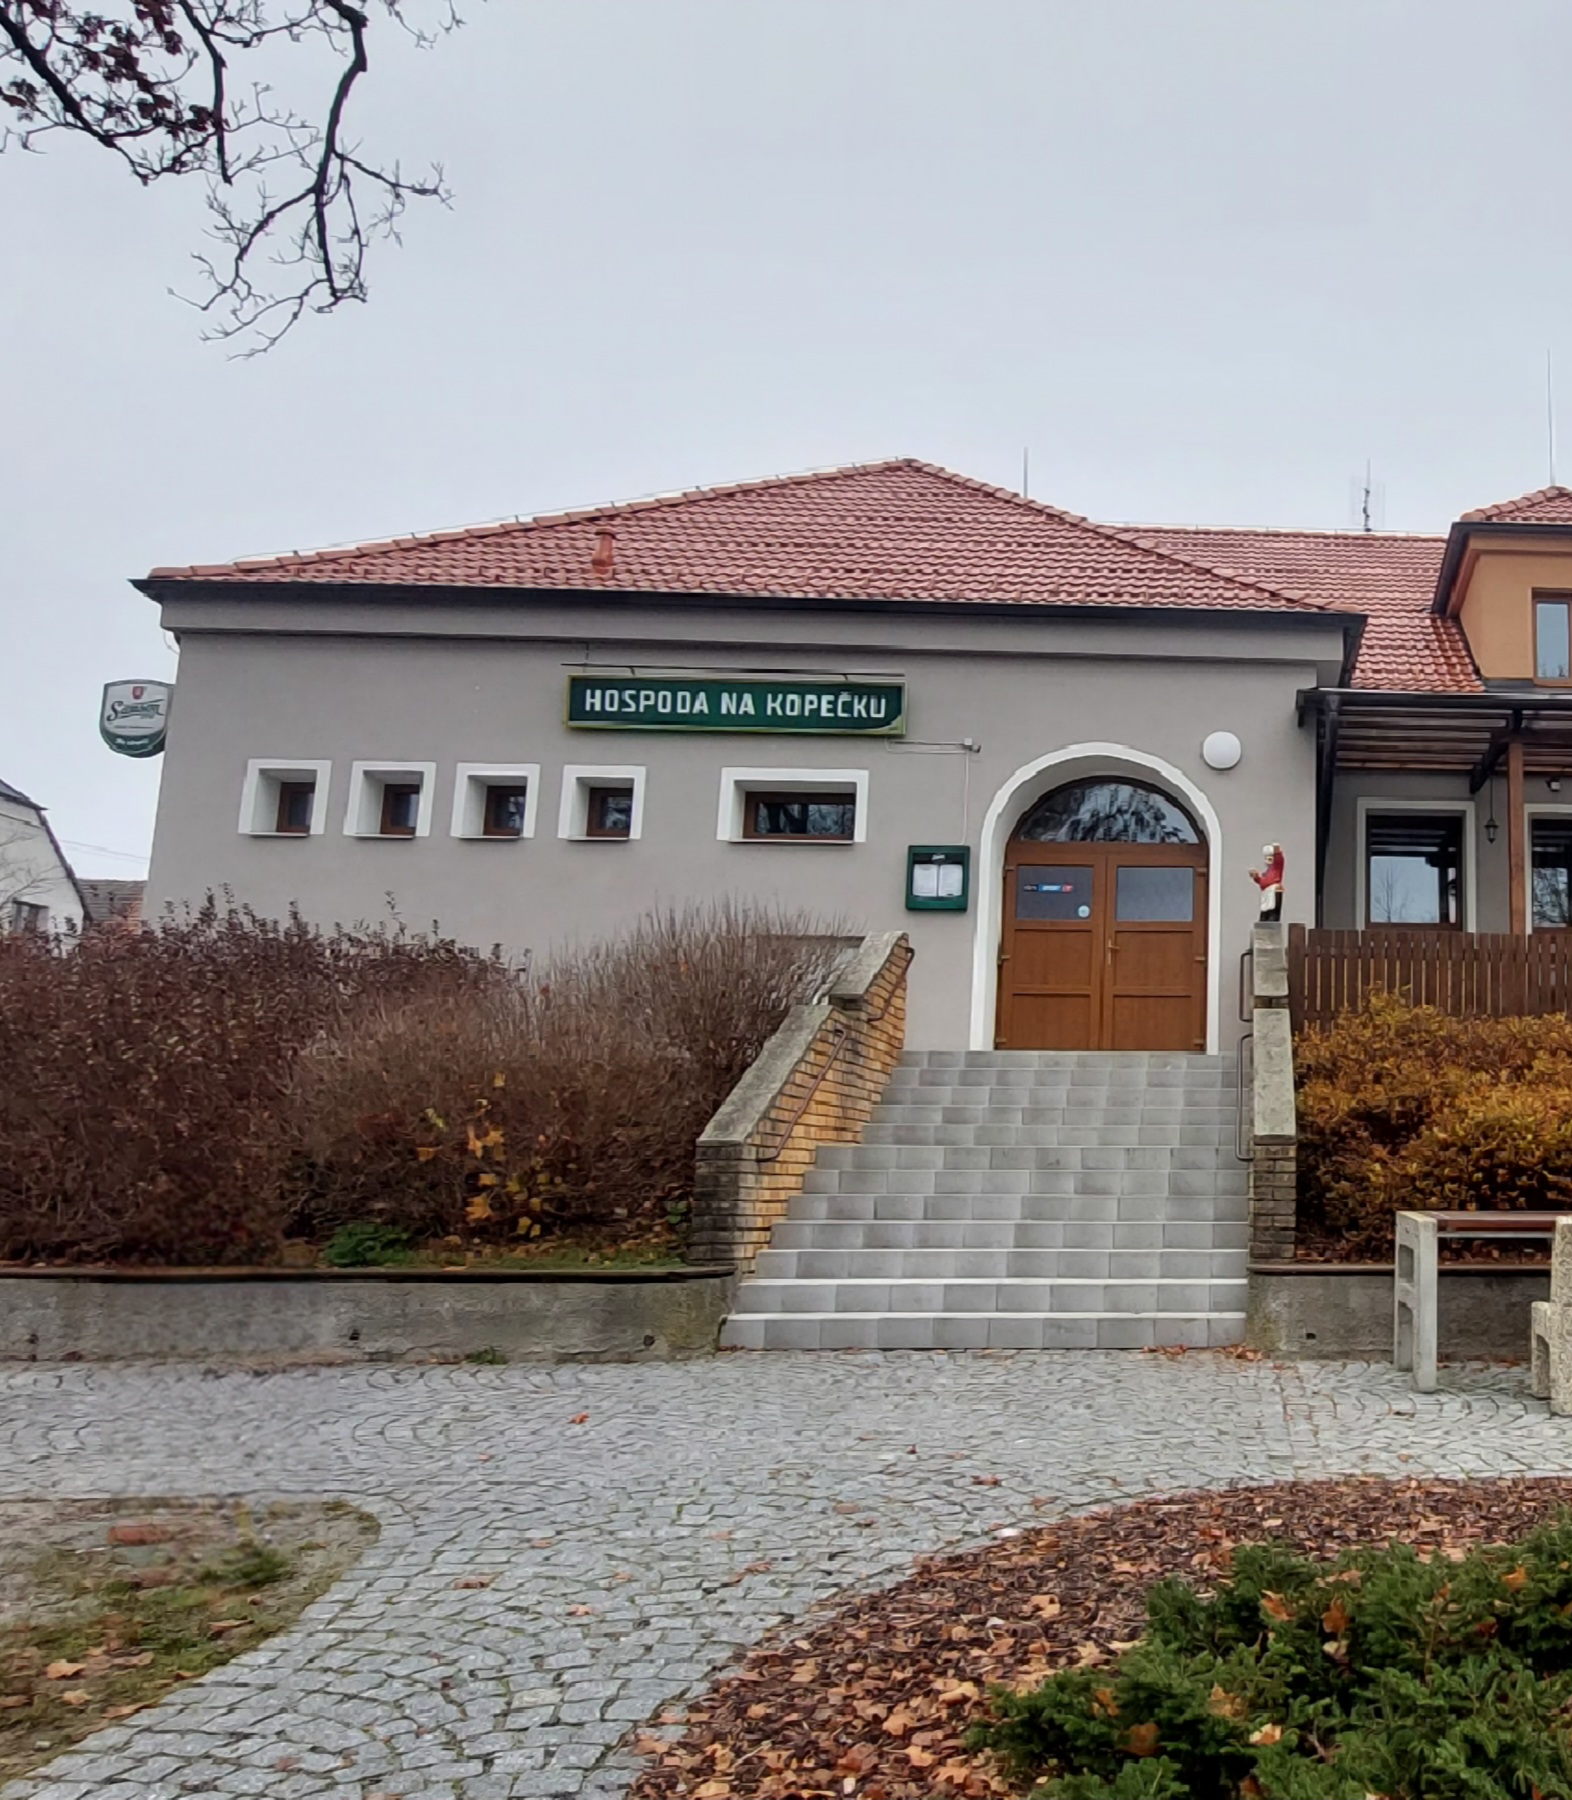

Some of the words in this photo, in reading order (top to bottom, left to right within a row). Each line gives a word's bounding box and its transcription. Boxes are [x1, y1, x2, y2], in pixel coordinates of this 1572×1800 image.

[585, 688, 709, 715] HOSPODA
[720, 692, 756, 716] NA
[766, 691, 887, 719] KOPEČKU
